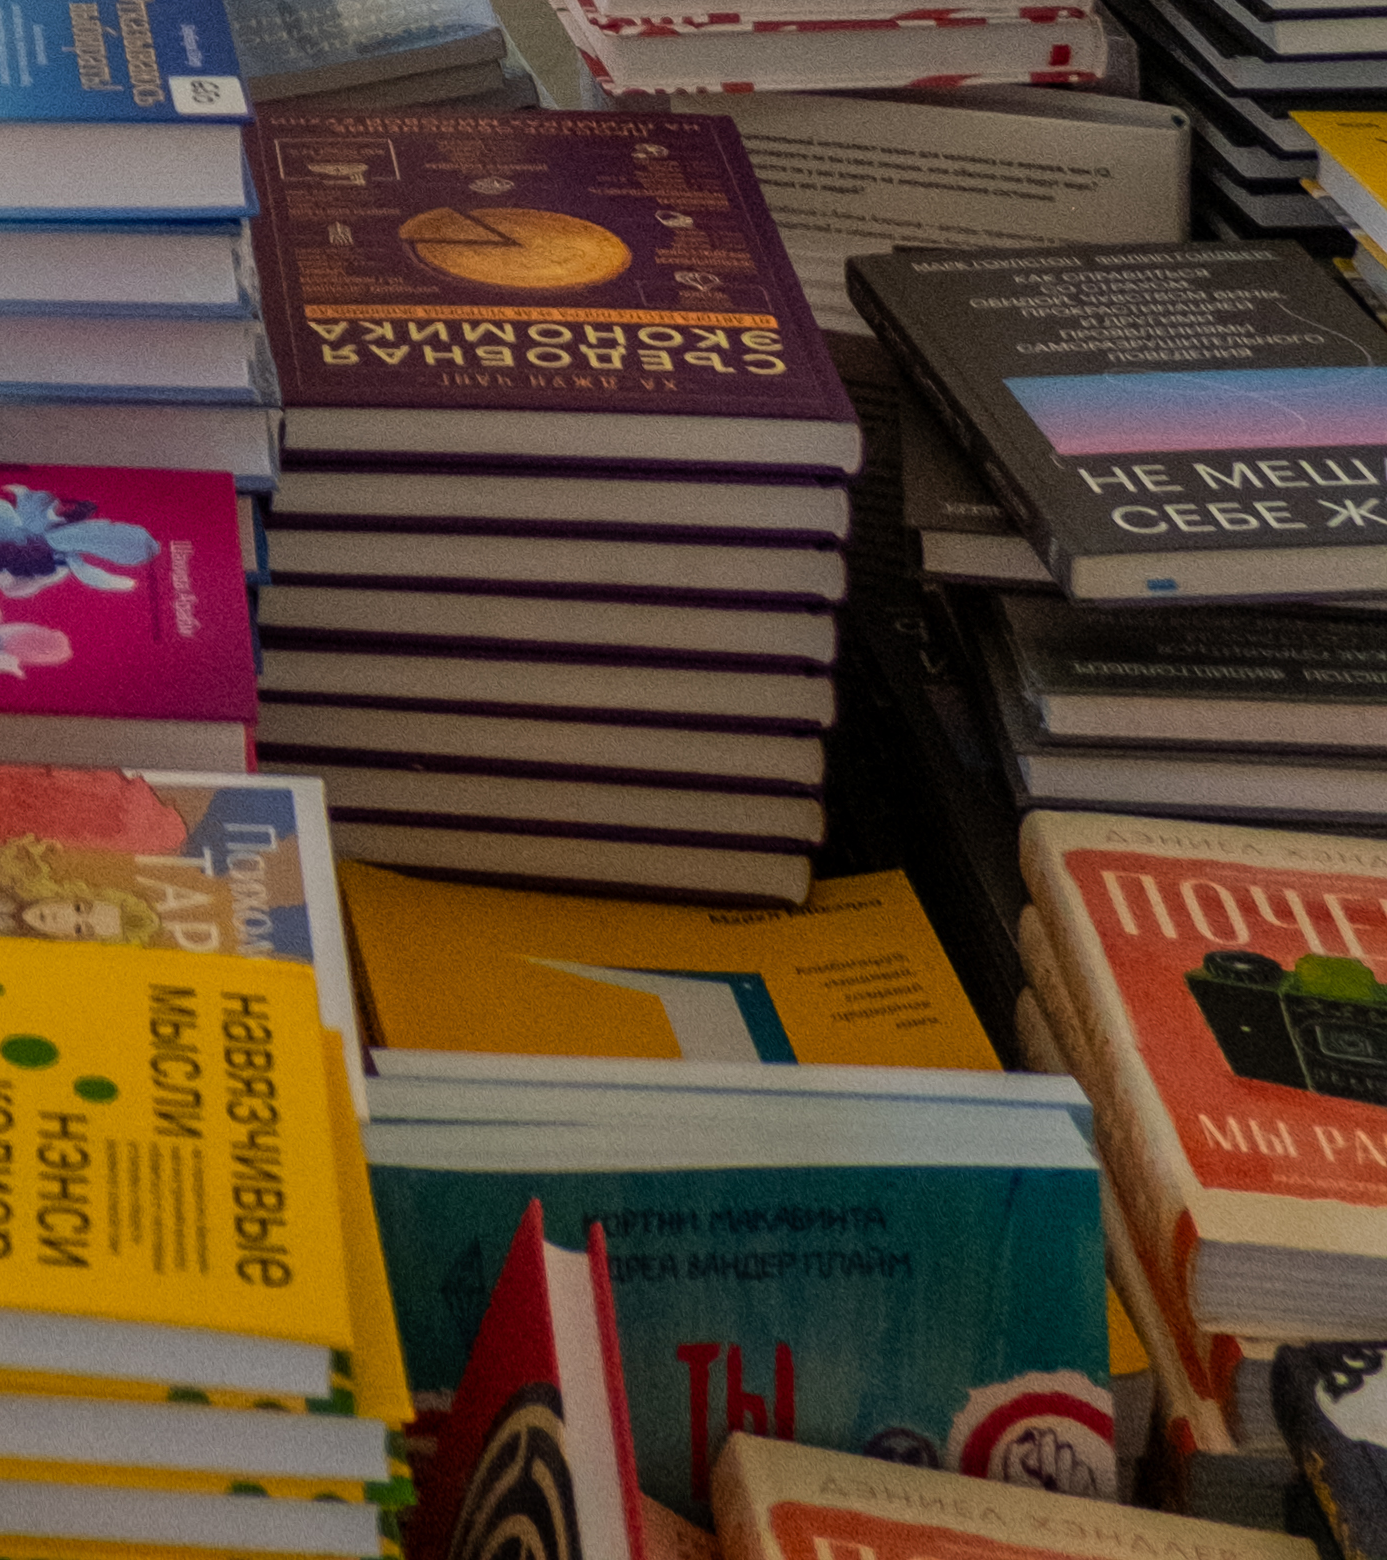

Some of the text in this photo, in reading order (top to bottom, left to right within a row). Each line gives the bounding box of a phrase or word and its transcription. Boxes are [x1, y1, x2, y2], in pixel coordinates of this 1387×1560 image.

[1010, 267, 1212, 284] КАК СПРАВИТЬСЯ
[1037, 284, 1070, 295] СО
[1018, 298, 1256, 319] ПРОКРАСТИНАЦИЕЙ
[1078, 289, 1209, 304] ЧУВСТВОМ
[305, 318, 785, 350] ЭКОНОМИКА
[1056, 323, 1256, 340] ПРОЯВЛЕНИЯМИ
[1100, 312, 1216, 328] ДРУГИМИ
[318, 339, 790, 375] СЪЕДОБНАЯ
[1013, 332, 1327, 354] САМОРАЗРУШИТЕЛЬНОГО
[1104, 346, 1256, 363] ПОВЕДЕНИЯ
[438, 372, 512, 386] ЧАНГ
[526, 373, 619, 389] ДЖУН
[1075, 456, 1387, 495] НЕ МЕШ
[1104, 497, 1387, 539] СЕБЕ Ж
[1103, 825, 1259, 851] ДЭНИЕЛ
[1098, 867, 1387, 952] ПОЧЕ
[145, 982, 206, 1142] мысли
[217, 990, 295, 1292] навязчивые
[1194, 1104, 1387, 1161] МЫ РА
[33, 1109, 93, 1271] нэнси
[603, 1248, 681, 1286] ДРЕА
[676, 1342, 798, 1506] ТЫ
